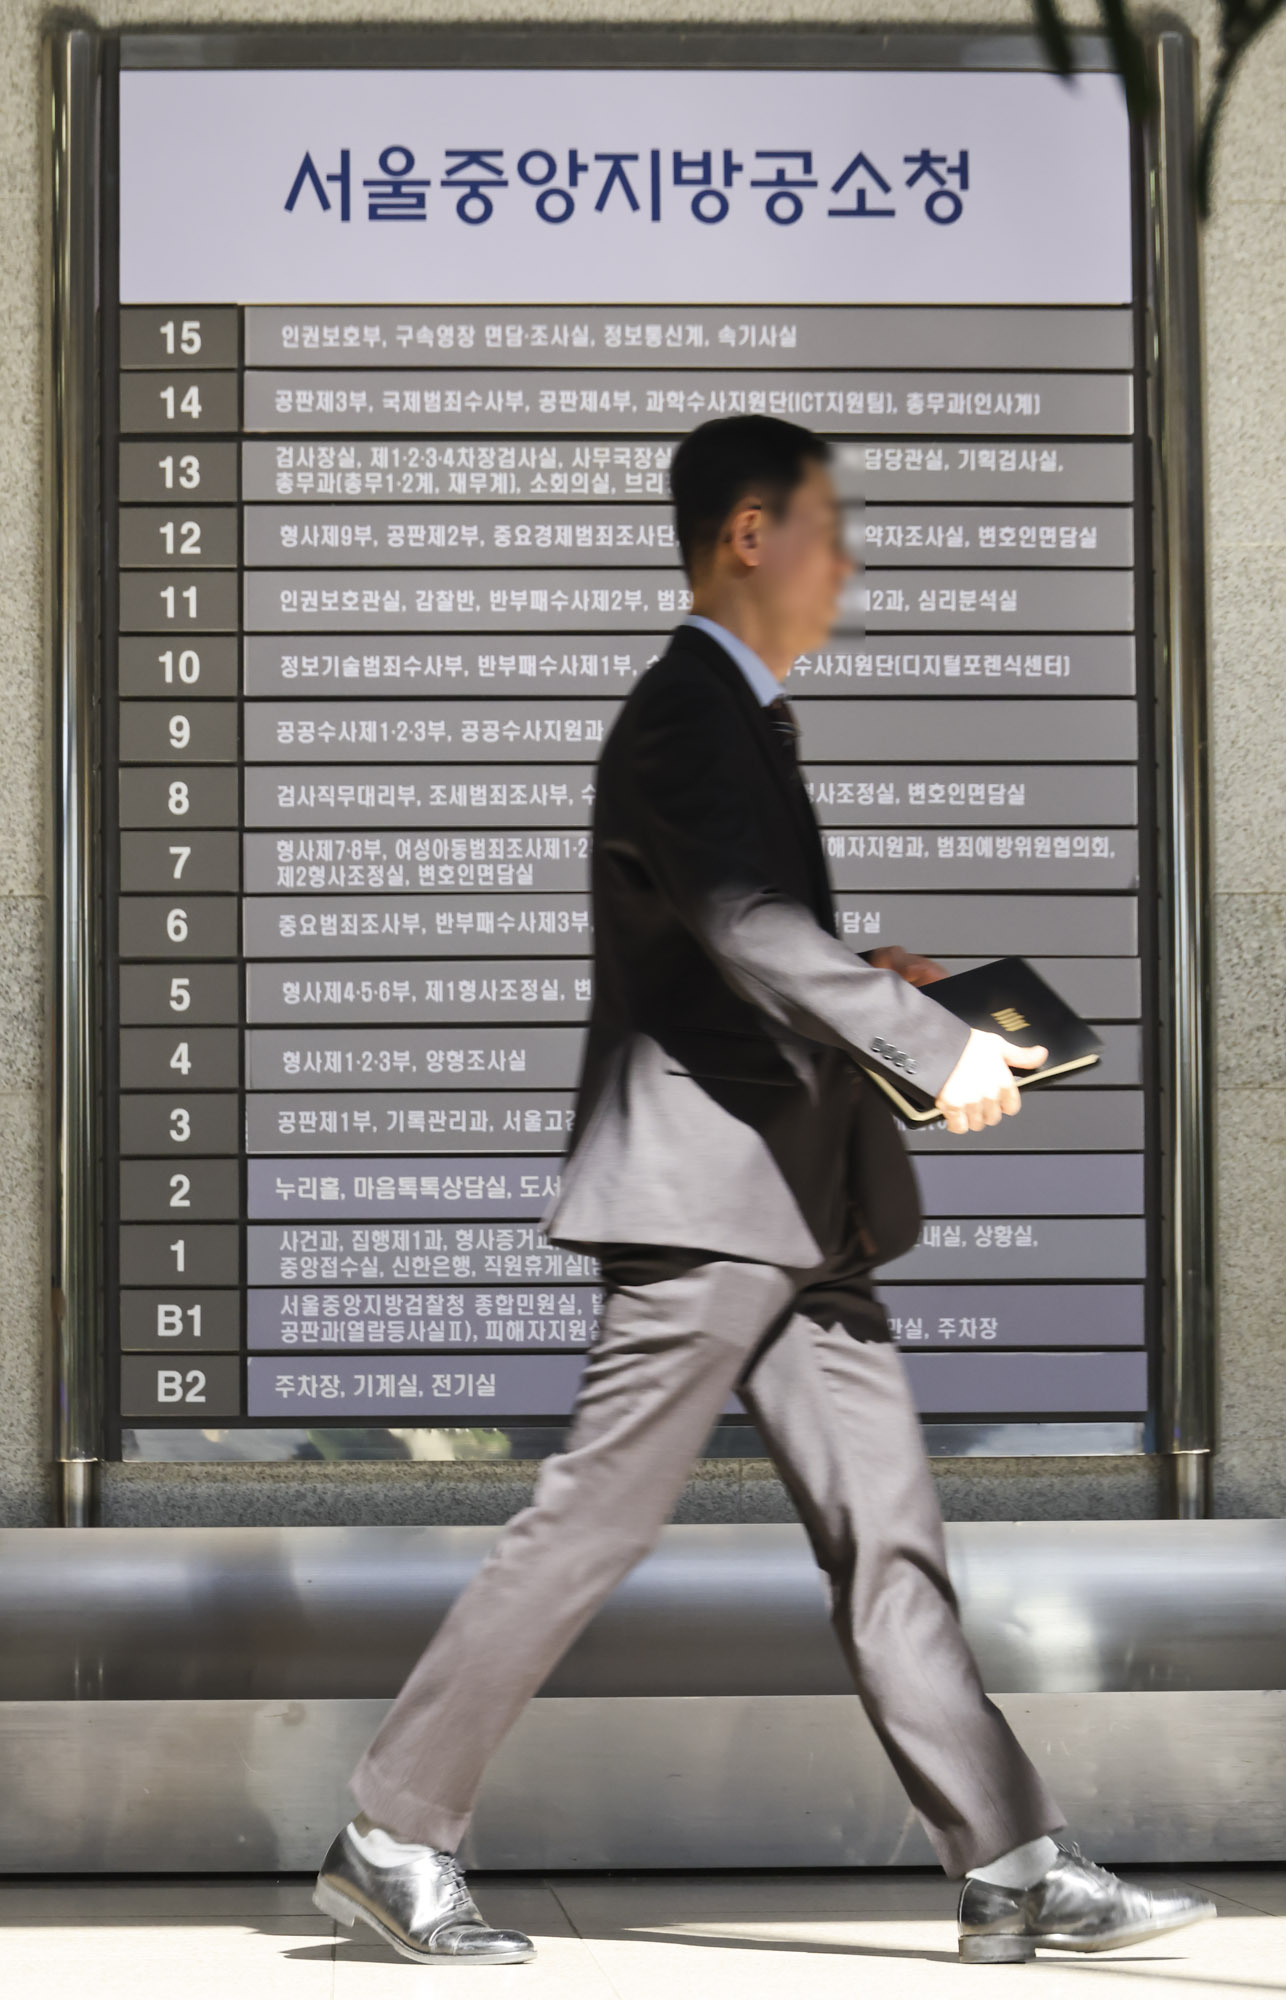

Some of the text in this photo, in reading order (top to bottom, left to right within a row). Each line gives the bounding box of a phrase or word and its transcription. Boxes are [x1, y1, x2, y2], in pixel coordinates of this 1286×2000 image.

[284, 145, 969, 225] 서울중앙지방공소청
[160, 321, 201, 354] 15
[282, 325, 387, 348] 인권보호부,
[396, 325, 475, 348] 구속영장
[605, 325, 710, 348] 정보통신계,
[718, 325, 797, 348] 속기사실
[160, 386, 202, 418] 14
[275, 390, 374, 413] 공판제3부,
[383, 390, 531, 413] 국제범죄수사부,
[539, 390, 638, 413] 공판제4부,
[159, 456, 200, 488] 13
[276, 447, 362, 471] 검사장실,
[864, 448, 949, 472] 담당관실,
[958, 449, 1064, 473] 기획검사실,
[531, 472, 617, 495] 소회의실,
[625, 472, 671, 494] 브리
[160, 522, 201, 554] 12
[280, 525, 379, 548] 형사제9부,
[387, 525, 485, 548] 공판제2부,
[865, 525, 970, 549] 약자조사실,
[979, 525, 1098, 549] 변호인면담실
[161, 586, 196, 618] 11
[280, 589, 1017, 613] 인권보호관실, 감찰반, 반부패수사제2부, 범죄 2과, 심리분석실
[159, 651, 200, 683] 10
[280, 654, 469, 679] 정보기술범죄수사부,
[478, 654, 638, 678] 반부패수사제1부,
[786, 654, 1070, 678] 수사지원단(디지털포렌식센터)
[169, 715, 190, 748] 9
[168, 782, 189, 815] 8
[277, 784, 422, 808] 검사직무대리부,
[430, 783, 574, 807] 조세범죄조사부,
[908, 782, 1026, 806] 변호인면담실
[170, 847, 191, 878] 7
[395, 836, 590, 862] 여성아동범죄조사제1·2
[824, 835, 930, 859] 해자지원과,
[276, 862, 534, 888] 제2형사조정실, 변호인면담실
[167, 909, 187, 942] 6
[279, 912, 427, 937] 중요범죄조사부,
[836, 912, 881, 934] 담실
[170, 978, 190, 1011] 5
[425, 978, 566, 1003] 제1형사조정실,
[170, 1043, 191, 1074] 4
[426, 1049, 526, 1074] 양형조사실
[170, 1108, 190, 1141] 3
[278, 1111, 378, 1135] 공판제1부,
[387, 1109, 494, 1133] 기록관리과,
[170, 1174, 190, 1207] 2
[276, 1176, 346, 1201] 누리홀,
[520, 1175, 559, 1199] 도서
[280, 1229, 344, 1254] 사건과,
[352, 1227, 448, 1253] 집행제1과,
[914, 1225, 967, 1248] 내실,
[974, 1224, 1039, 1248] 상황실,
[171, 1240, 184, 1271] 1
[280, 1255, 387, 1279] 중앙접수실,
[392, 1254, 477, 1279] 신한은행,
[281, 1293, 465, 1317] 서울중앙지방검찰청
[475, 1292, 583, 1317] 종합민원실,
[158, 1305, 201, 1336] B1
[938, 1317, 999, 1341] 주차장
[158, 1370, 205, 1402] B2
[275, 1373, 496, 1399] 주차장, 기계실, 전기실
